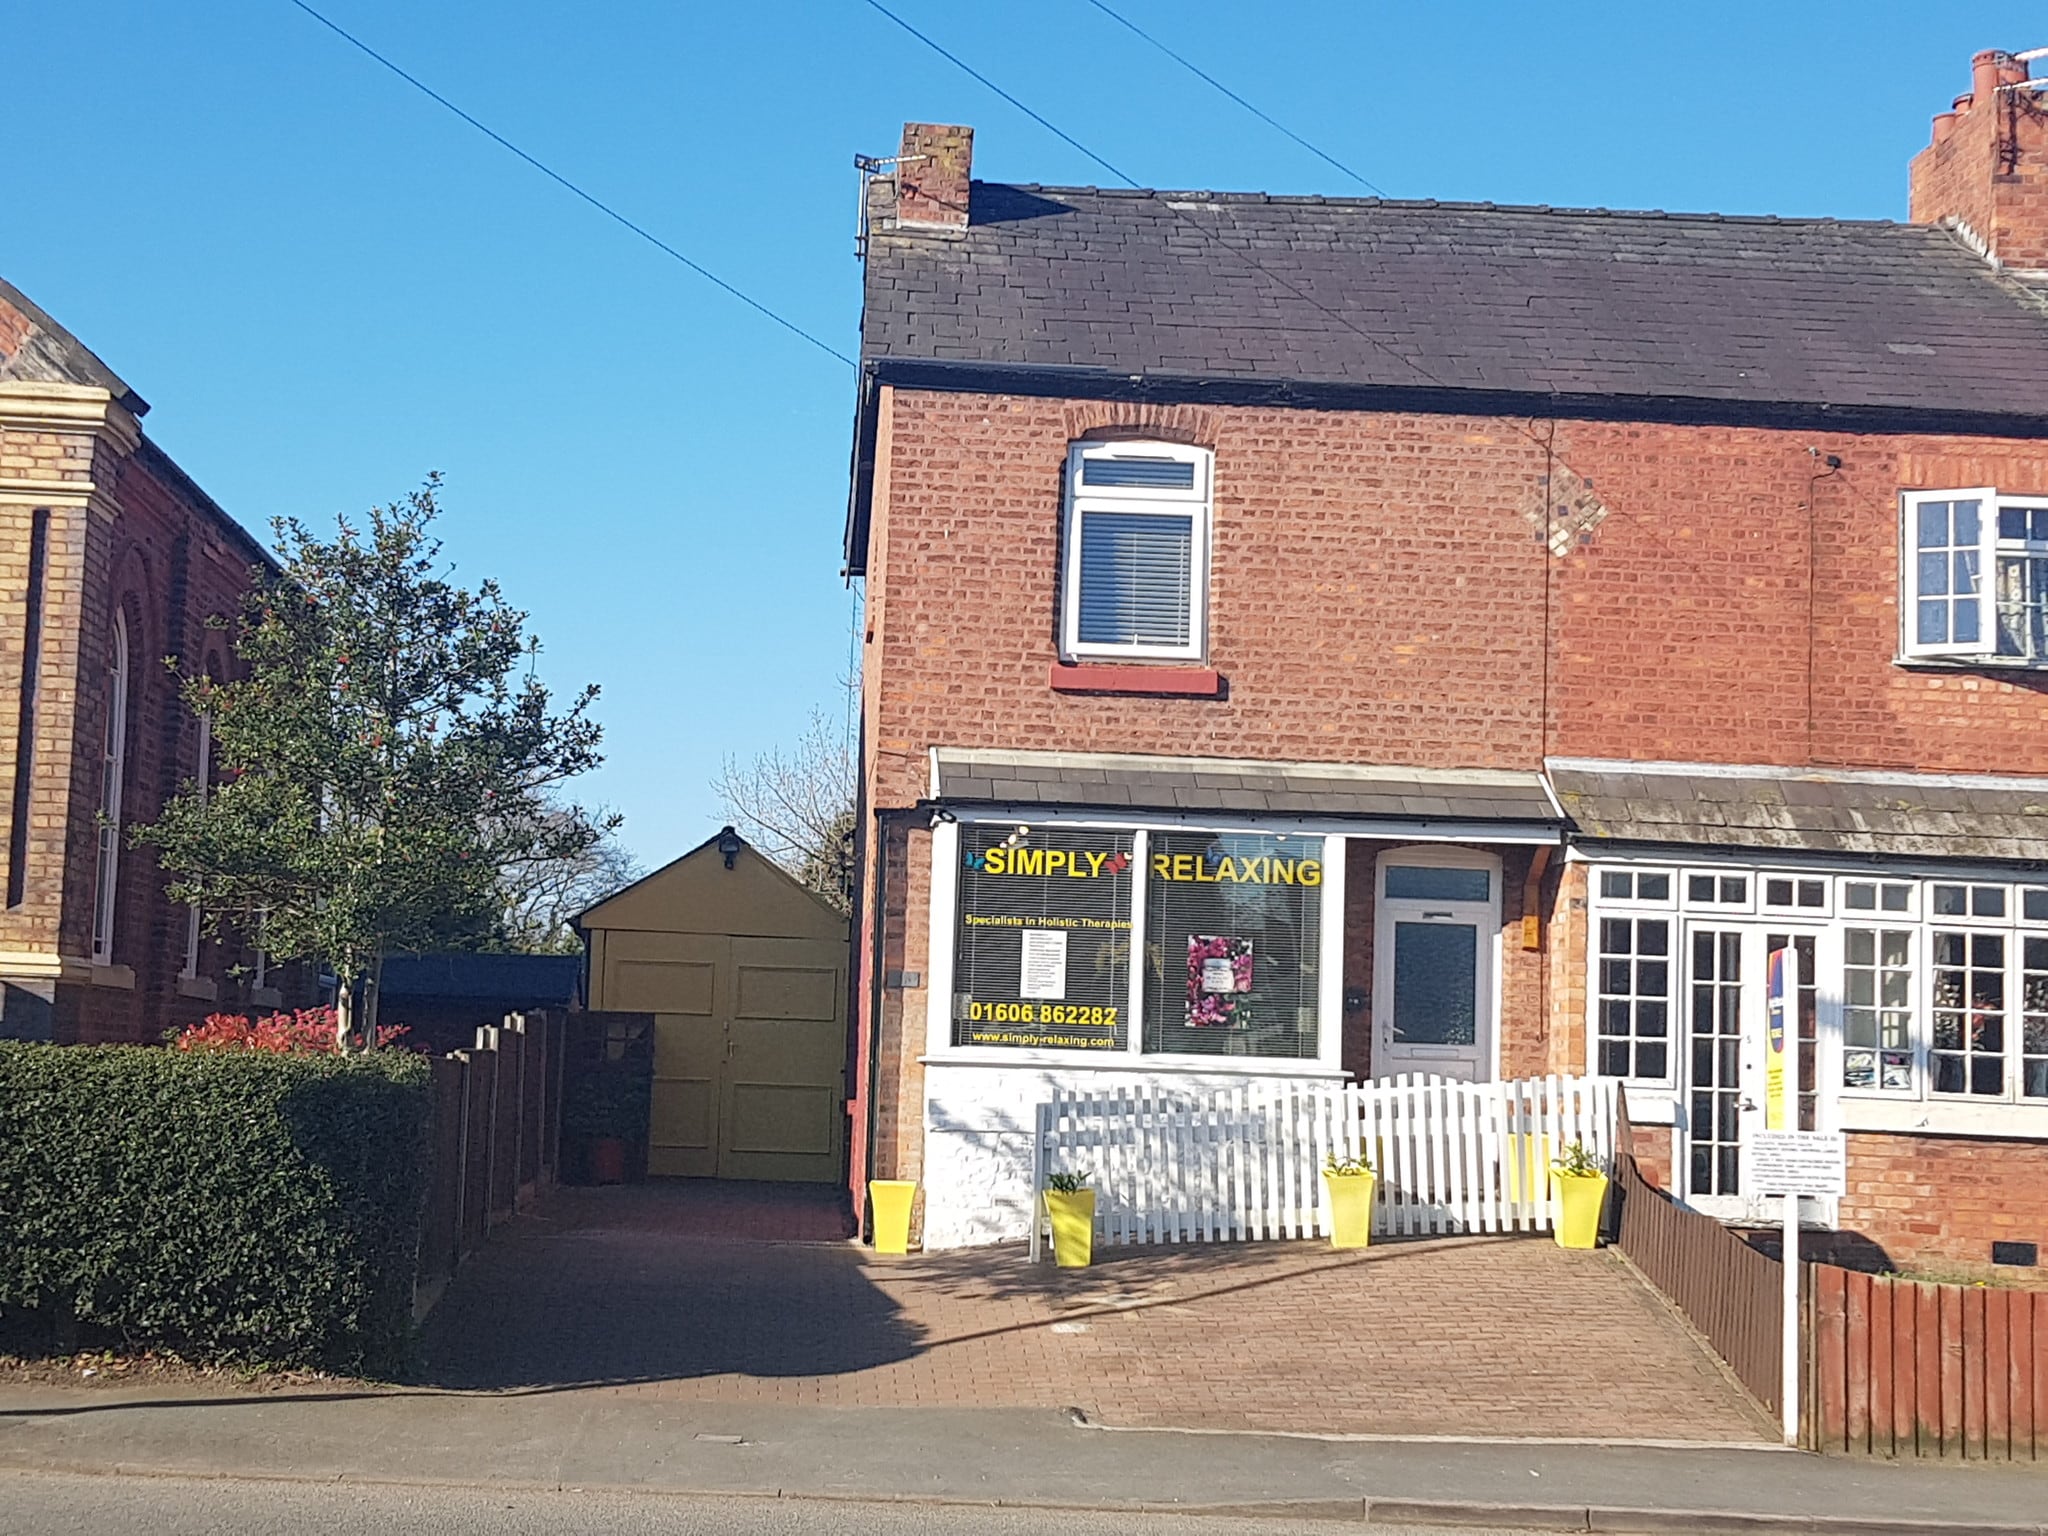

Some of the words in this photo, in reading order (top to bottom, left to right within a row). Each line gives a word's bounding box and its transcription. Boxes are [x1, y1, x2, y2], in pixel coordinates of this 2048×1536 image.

[983, 847, 1108, 878] SIMPLY
[1153, 854, 1322, 887] RELAXING
[965, 914, 1023, 927] Specialists
[1038, 916, 1079, 927] Holistic
[1081, 918, 1134, 930] Therapies
[970, 1002, 1034, 1022] 01606
[1039, 1005, 1118, 1026] 862282
[972, 1032, 1115, 1047] www.simply-relaxing.com
